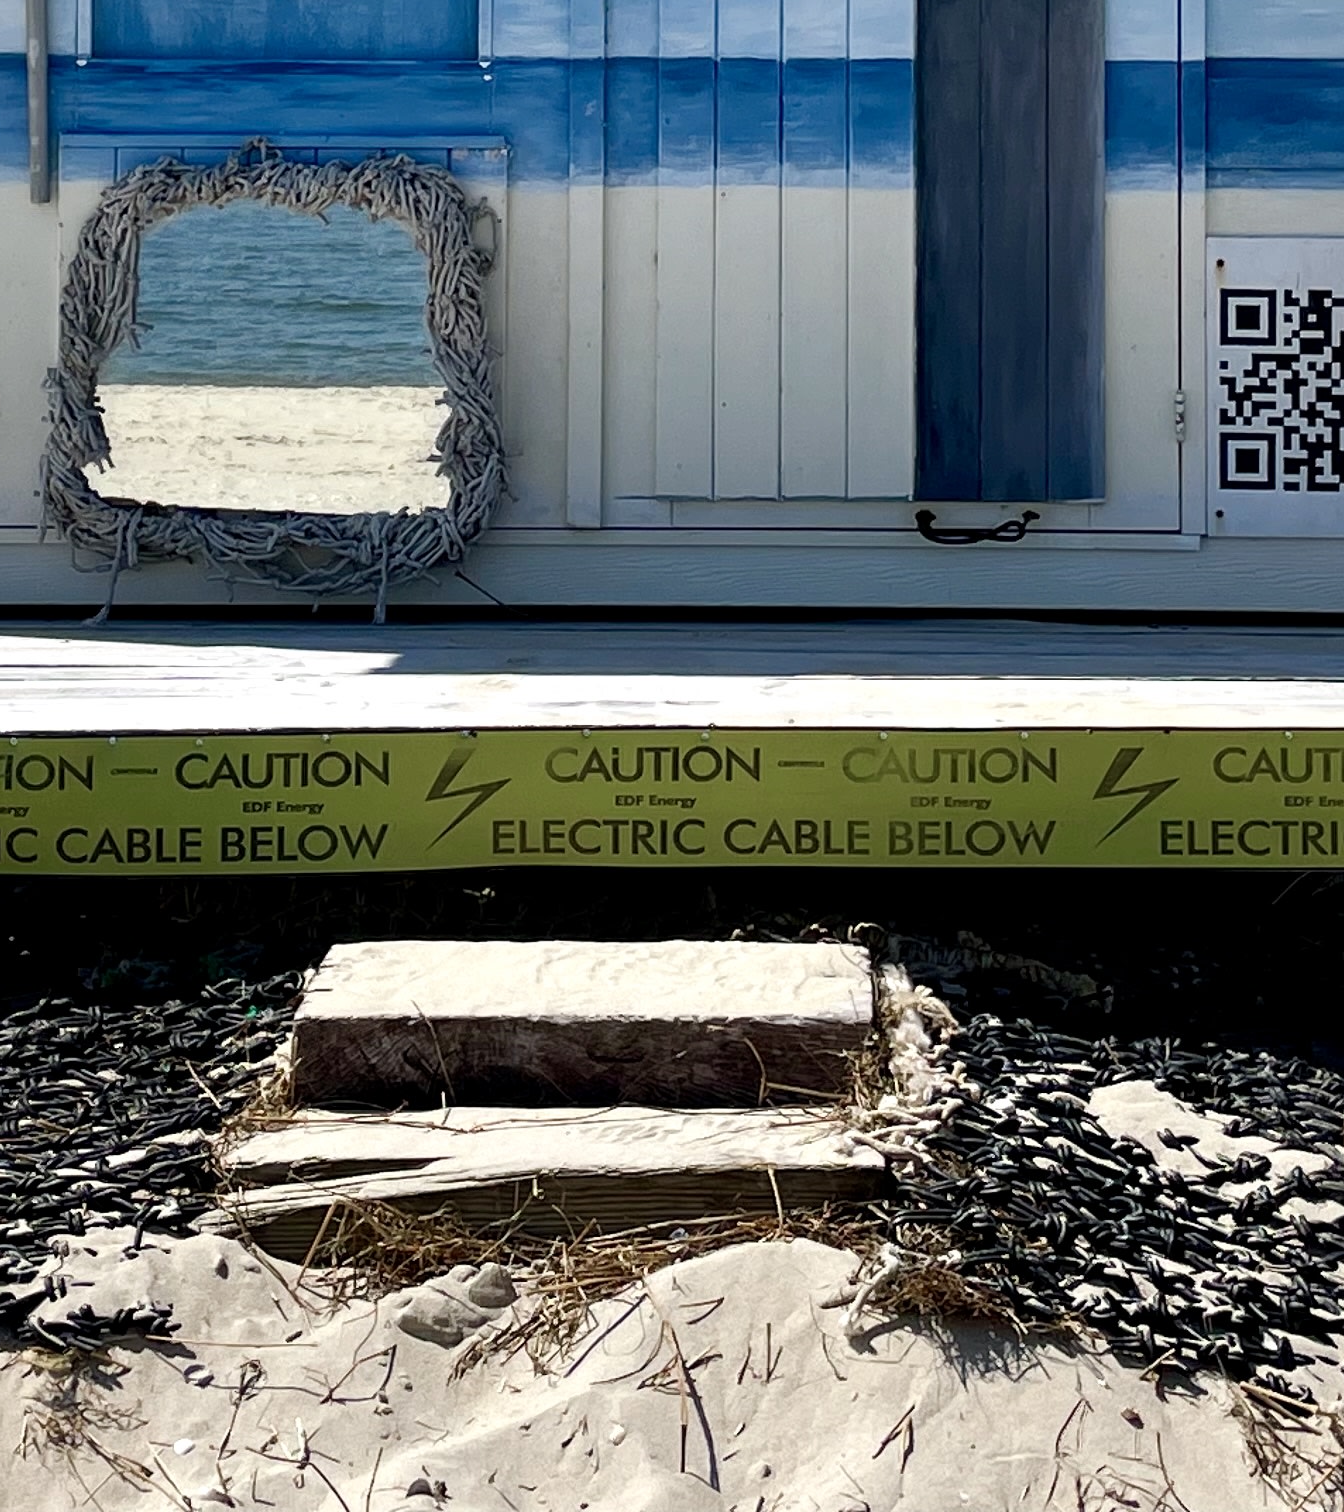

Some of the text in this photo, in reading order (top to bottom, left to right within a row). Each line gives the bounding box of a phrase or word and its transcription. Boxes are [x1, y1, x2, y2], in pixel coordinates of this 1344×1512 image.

[174, 751, 391, 789] CAUTION
[544, 746, 761, 783] CAUTION
[842, 747, 1057, 784] CAUTION
[242, 800, 272, 814] EDF
[275, 800, 325, 816] Energy
[614, 794, 644, 807] EDF
[648, 794, 697, 810] Energy
[910, 796, 939, 808] EDF
[944, 796, 992, 811] Energy
[1284, 795, 1314, 808] EDF
[55, 827, 203, 864] CABLE
[219, 823, 390, 863] BELOW
[491, 818, 706, 856] ELECTRIC
[723, 818, 870, 856] CABLE
[887, 819, 1057, 857] BELOW
